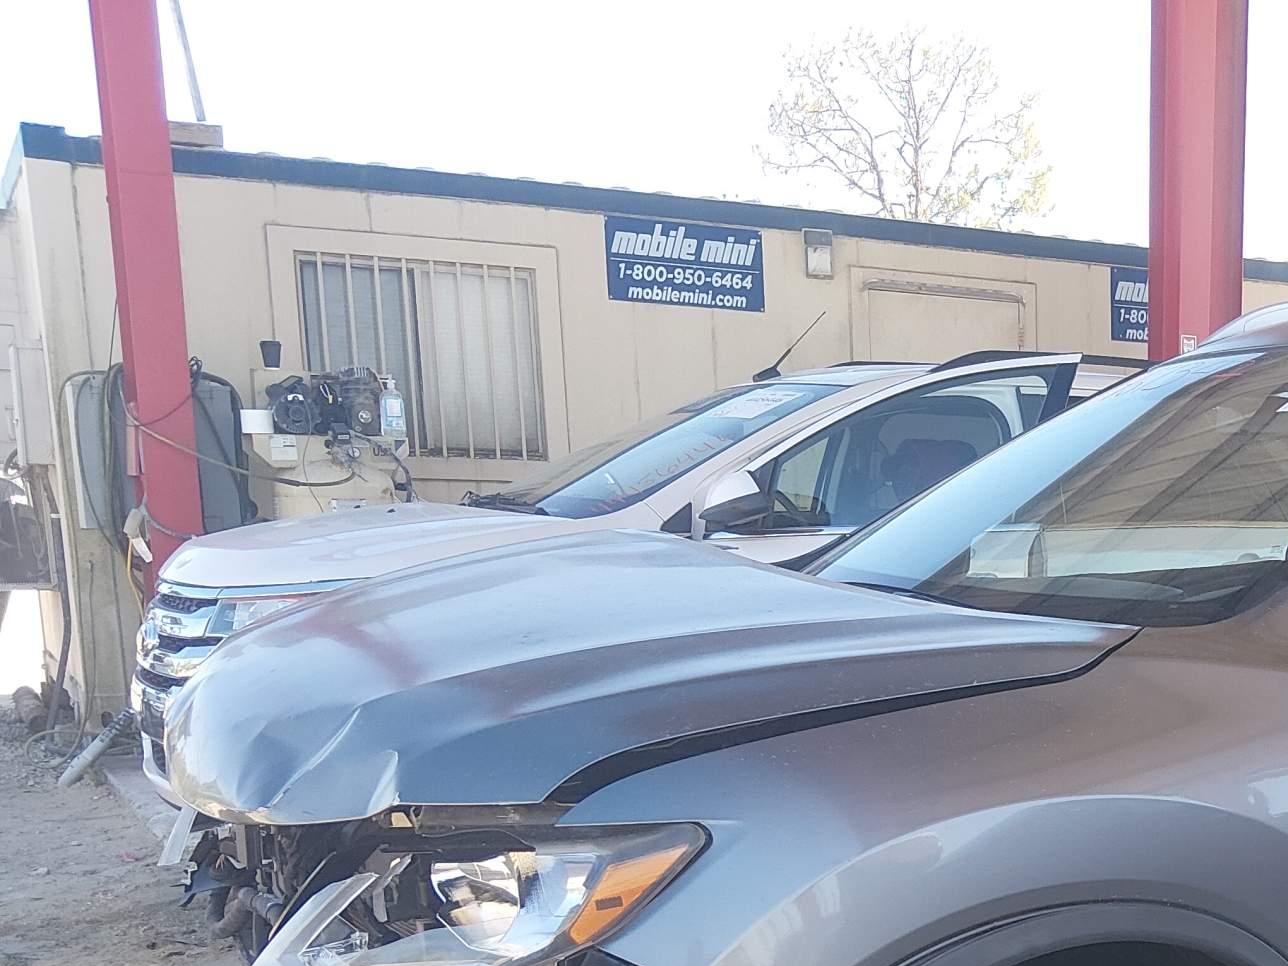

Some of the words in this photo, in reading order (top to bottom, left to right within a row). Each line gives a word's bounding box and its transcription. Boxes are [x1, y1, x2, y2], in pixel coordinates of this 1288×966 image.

[611, 224, 698, 260] mobile
[700, 236, 758, 266] mini
[618, 263, 753, 290] 1-800-950-6464
[628, 286, 747, 308] mobilemini.com
[1120, 309, 1149, 324] 1-80
